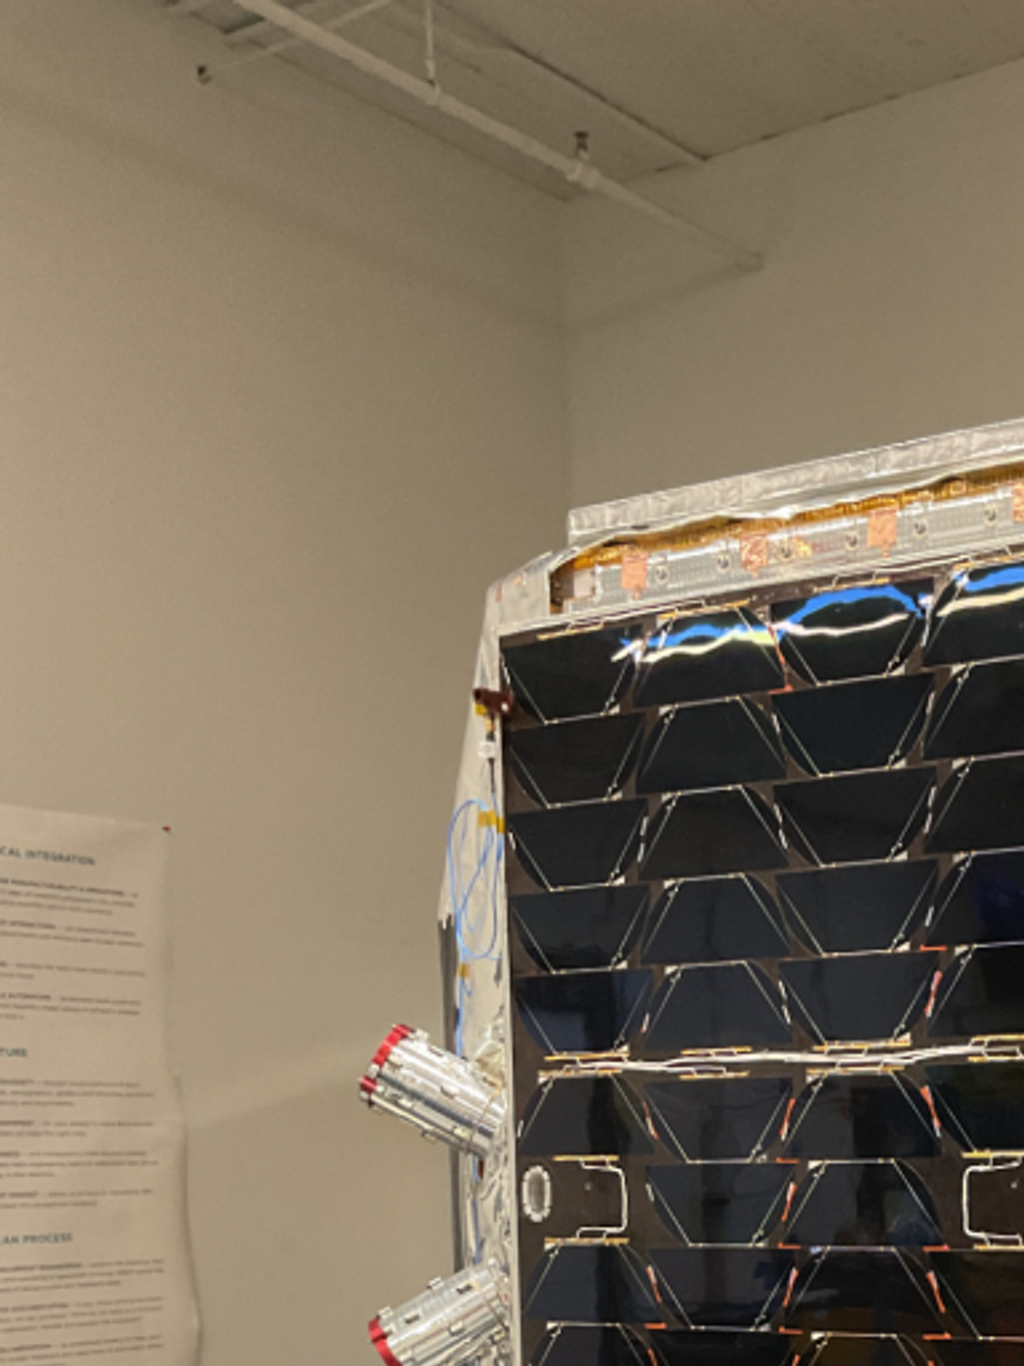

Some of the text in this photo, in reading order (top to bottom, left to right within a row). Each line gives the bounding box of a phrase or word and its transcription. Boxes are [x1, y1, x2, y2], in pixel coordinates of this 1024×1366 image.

[25, 850, 96, 866] INTEGRATION
[0, 1232, 73, 1245] AN PROCESS
